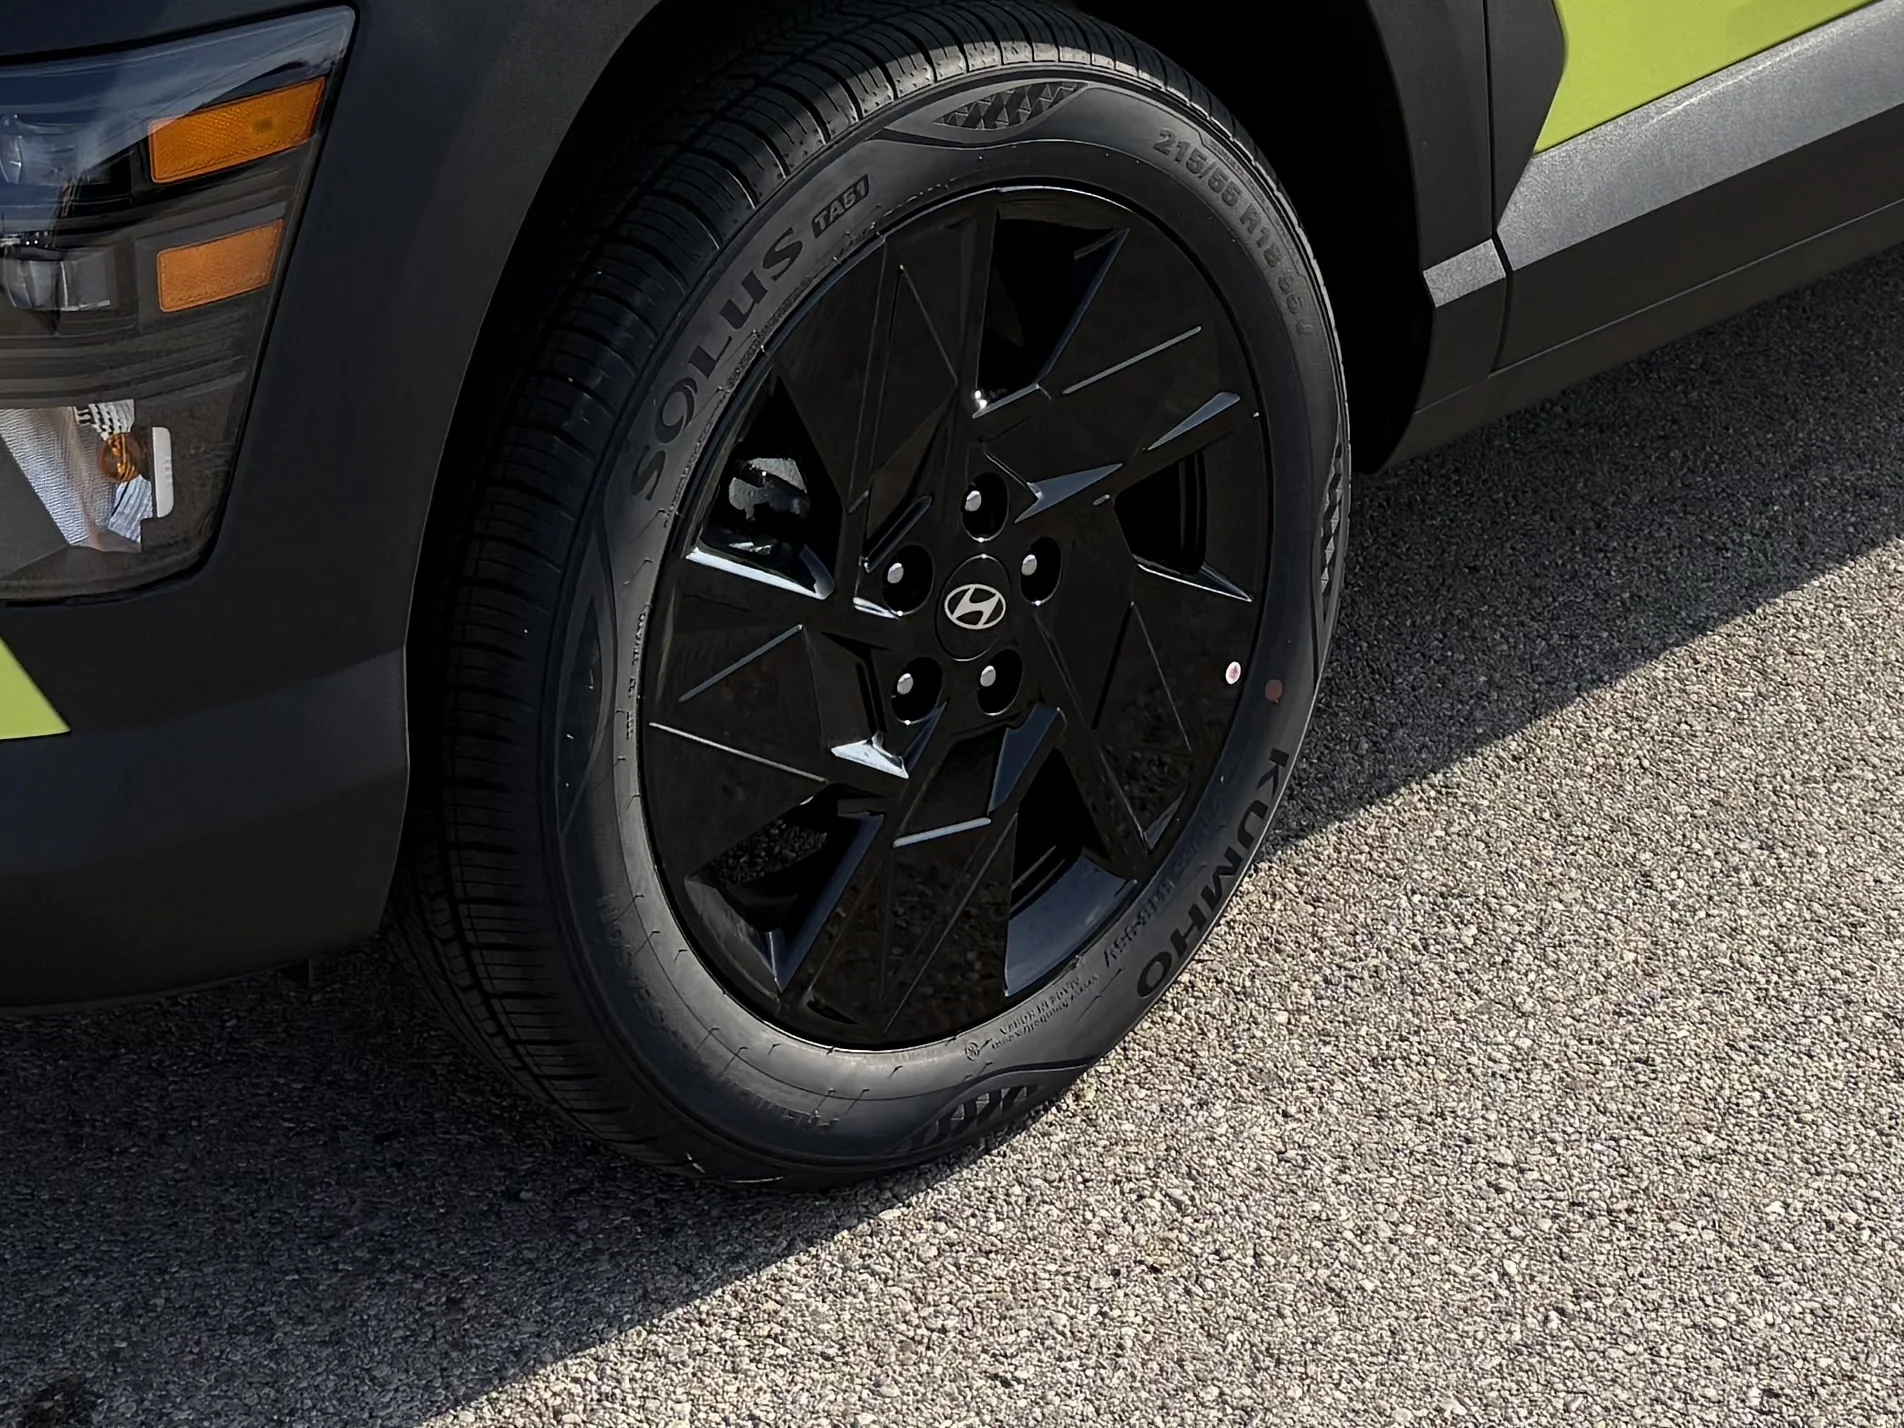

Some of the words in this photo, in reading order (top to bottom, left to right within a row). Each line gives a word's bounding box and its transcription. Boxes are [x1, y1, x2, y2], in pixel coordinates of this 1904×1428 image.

[1153, 128, 1242, 207] 215/55
[1239, 203, 1283, 268] R18
[630, 227, 803, 502] SOLUS
[1137, 748, 1290, 999] KUMHO
